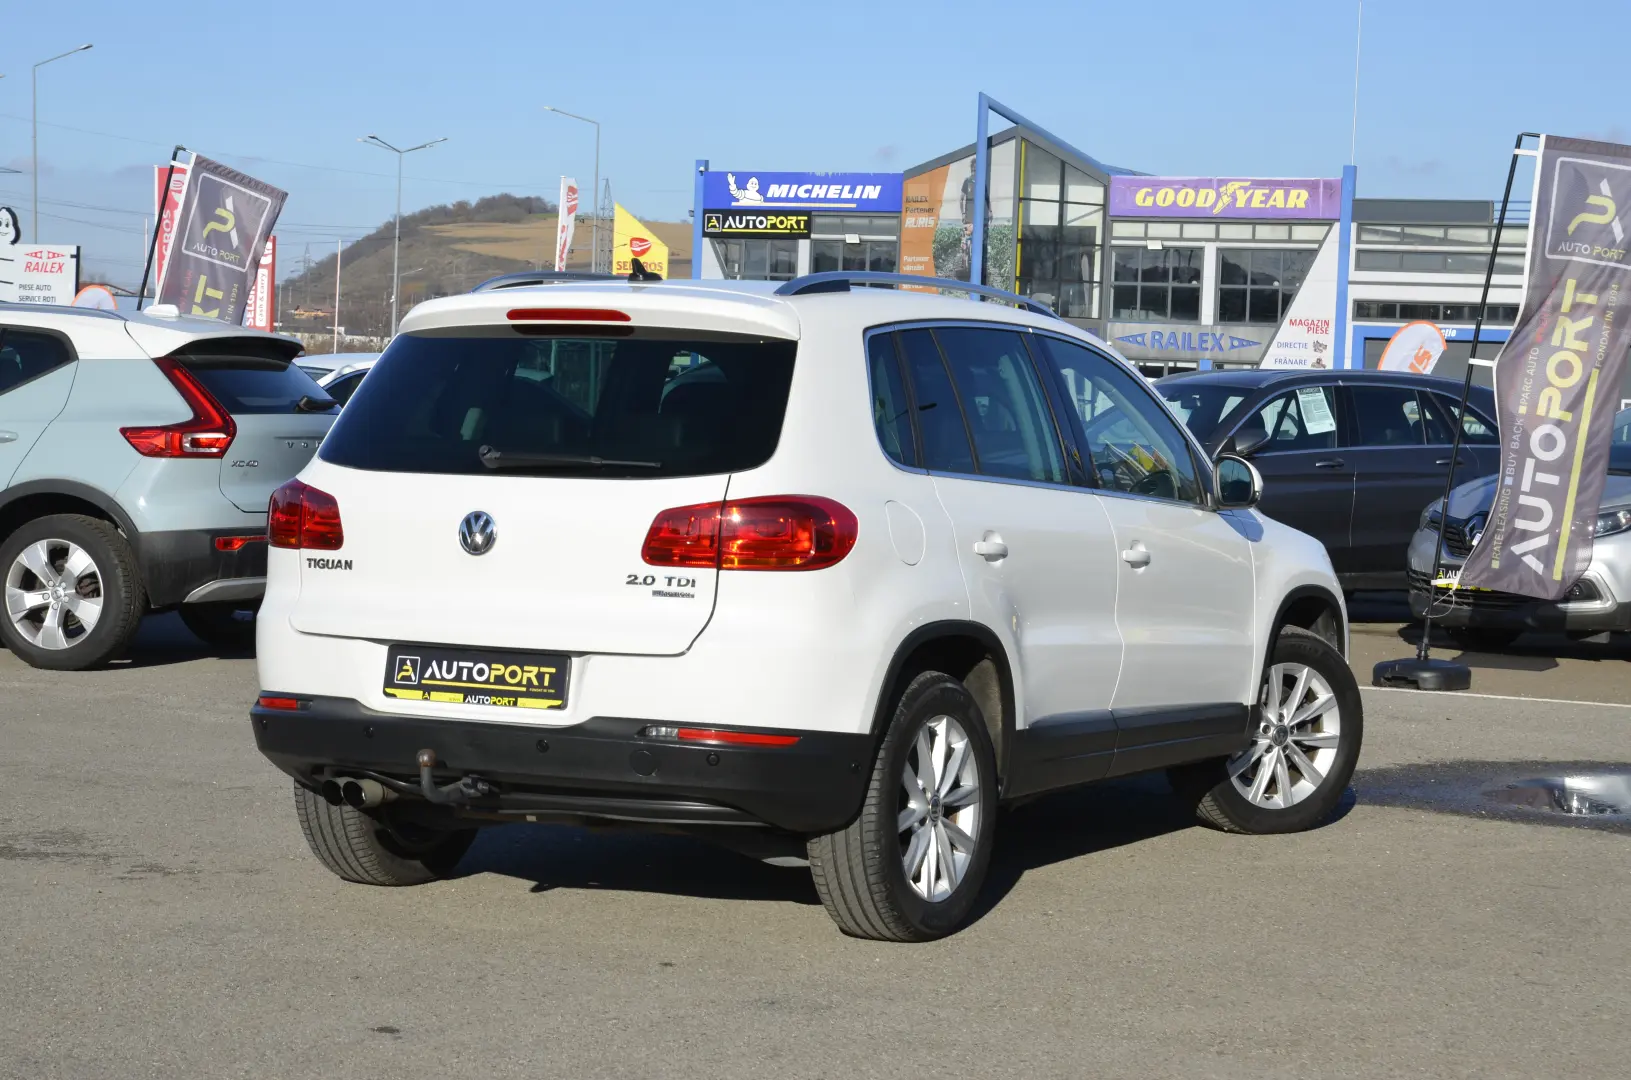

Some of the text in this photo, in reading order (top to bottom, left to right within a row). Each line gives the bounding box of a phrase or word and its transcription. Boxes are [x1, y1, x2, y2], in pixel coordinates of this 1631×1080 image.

[766, 184, 882, 200] MICHELIN
[723, 215, 808, 229] AUTOPORT
[193, 242, 241, 264] AUTO PORT
[1557, 242, 1626, 260] AUTO PORT
[24, 262, 65, 274] RAILEX
[616, 261, 664, 272] SELROS
[18, 283, 52, 292] PIESE AUTO
[18, 295, 41, 303] SERVICE
[246, 286, 255, 326] SELG
[1289, 318, 1330, 327] MAGAZIN
[1595, 284, 1620, 368] FONDAT IN 1994
[1306, 326, 1329, 335] PIESE
[1150, 331, 1225, 353] RAILEX
[1510, 278, 1598, 576] AUTOPORT
[1492, 347, 1540, 561] RATE LEASING BUY BACK PARC AUTO
[306, 557, 353, 571] TIGUAN
[625, 574, 697, 588] 2.0 TDI
[423, 659, 556, 687] AUTOPORT
[465, 694, 515, 707] AUTOPORT
